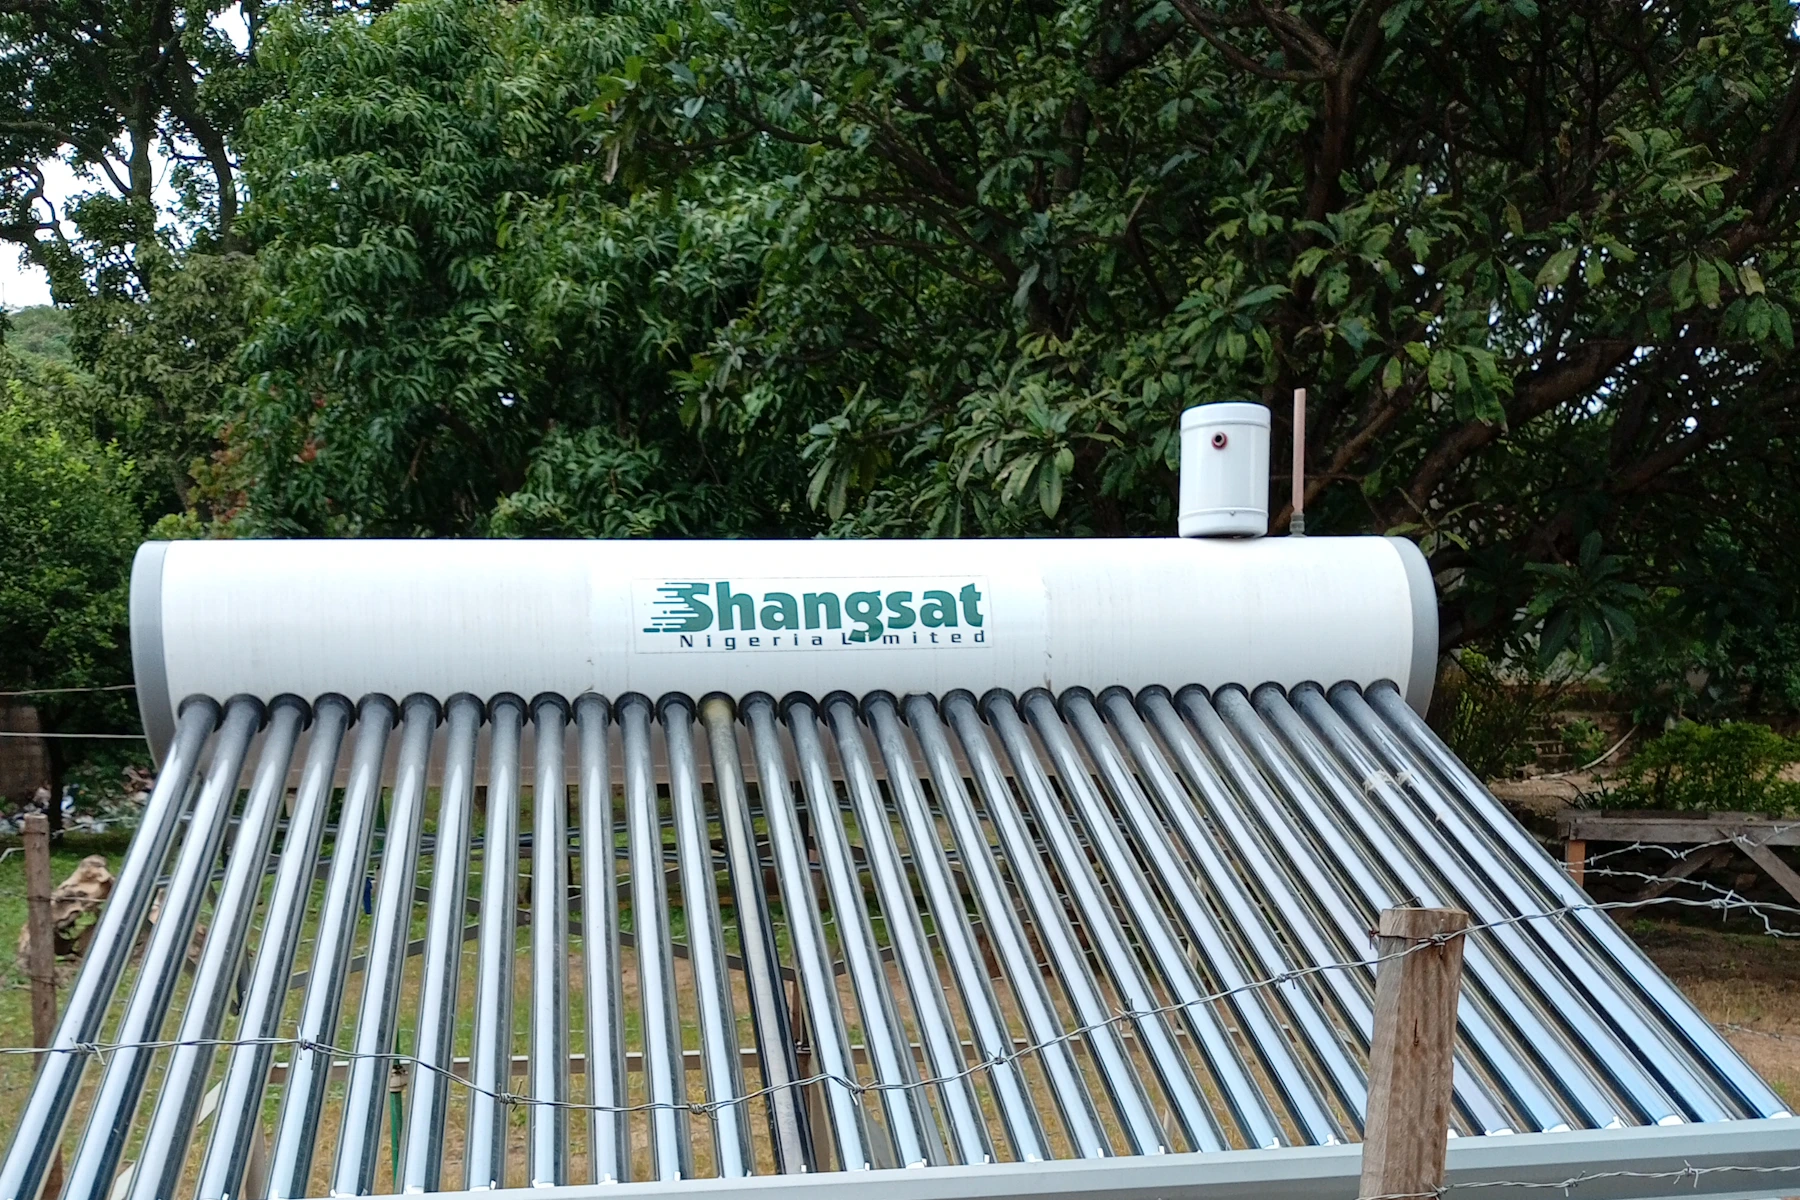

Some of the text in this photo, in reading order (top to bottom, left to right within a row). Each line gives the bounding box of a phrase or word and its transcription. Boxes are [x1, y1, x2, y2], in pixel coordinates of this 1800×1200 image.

[644, 581, 984, 643] Shangsat
[679, 630, 986, 650] Nigeria Limited
